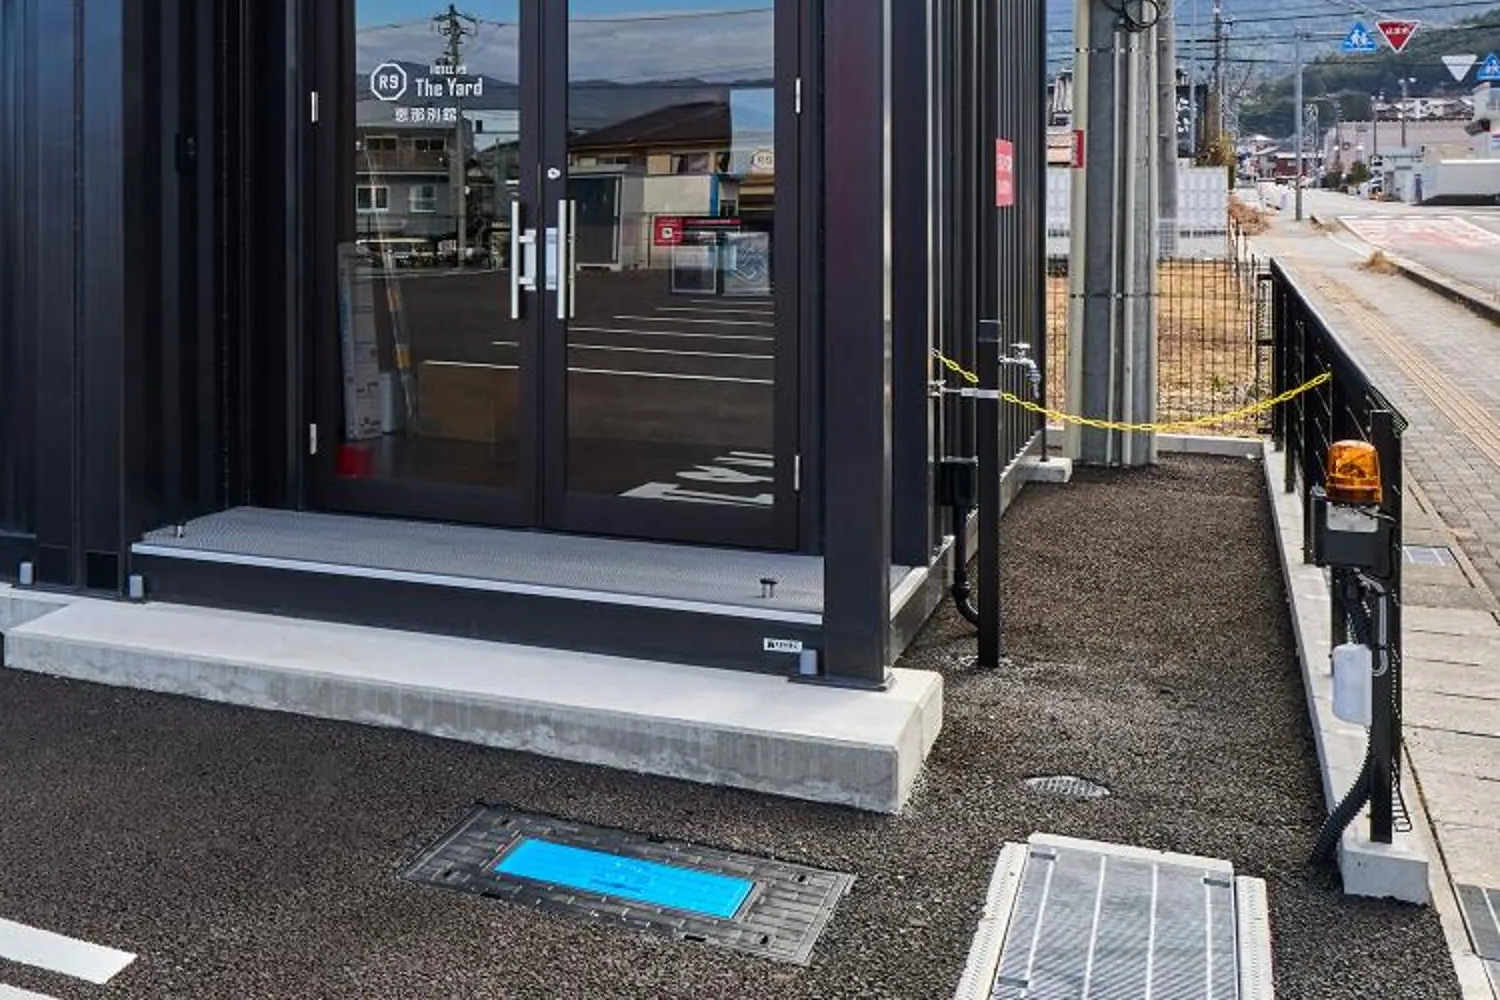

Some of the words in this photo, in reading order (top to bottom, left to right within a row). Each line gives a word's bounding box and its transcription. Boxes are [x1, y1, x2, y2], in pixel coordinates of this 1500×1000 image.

[379, 74, 399, 90] R9
[415, 79, 443, 97] The
[447, 77, 483, 97] Yard
